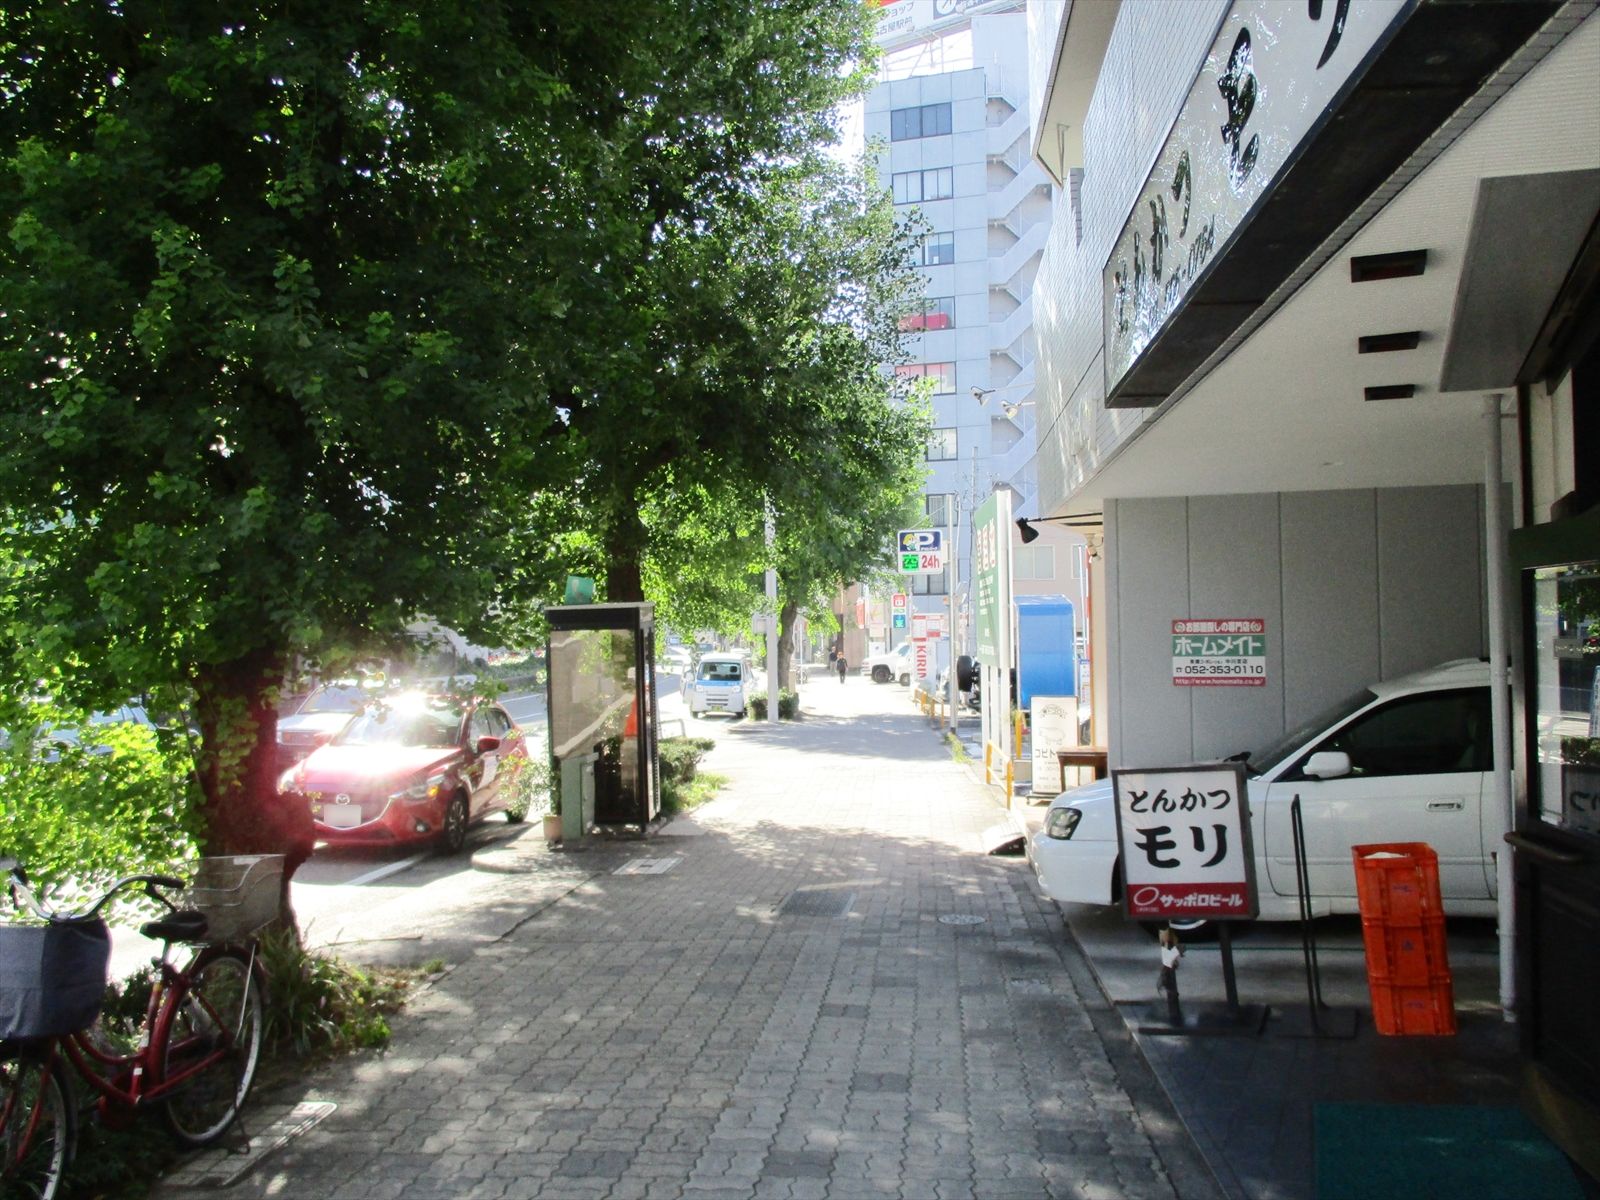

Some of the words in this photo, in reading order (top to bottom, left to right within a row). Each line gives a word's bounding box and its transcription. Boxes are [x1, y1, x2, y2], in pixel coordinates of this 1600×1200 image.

[921, 555, 940, 568] 24h
[1174, 636, 1261, 655] ホームメイト
[1184, 665, 1263, 674] 052-353-0110
[1128, 787, 1231, 813] とんかつ
[1134, 824, 1227, 868] モリ
[1160, 893, 1243, 907] サッポロビール
